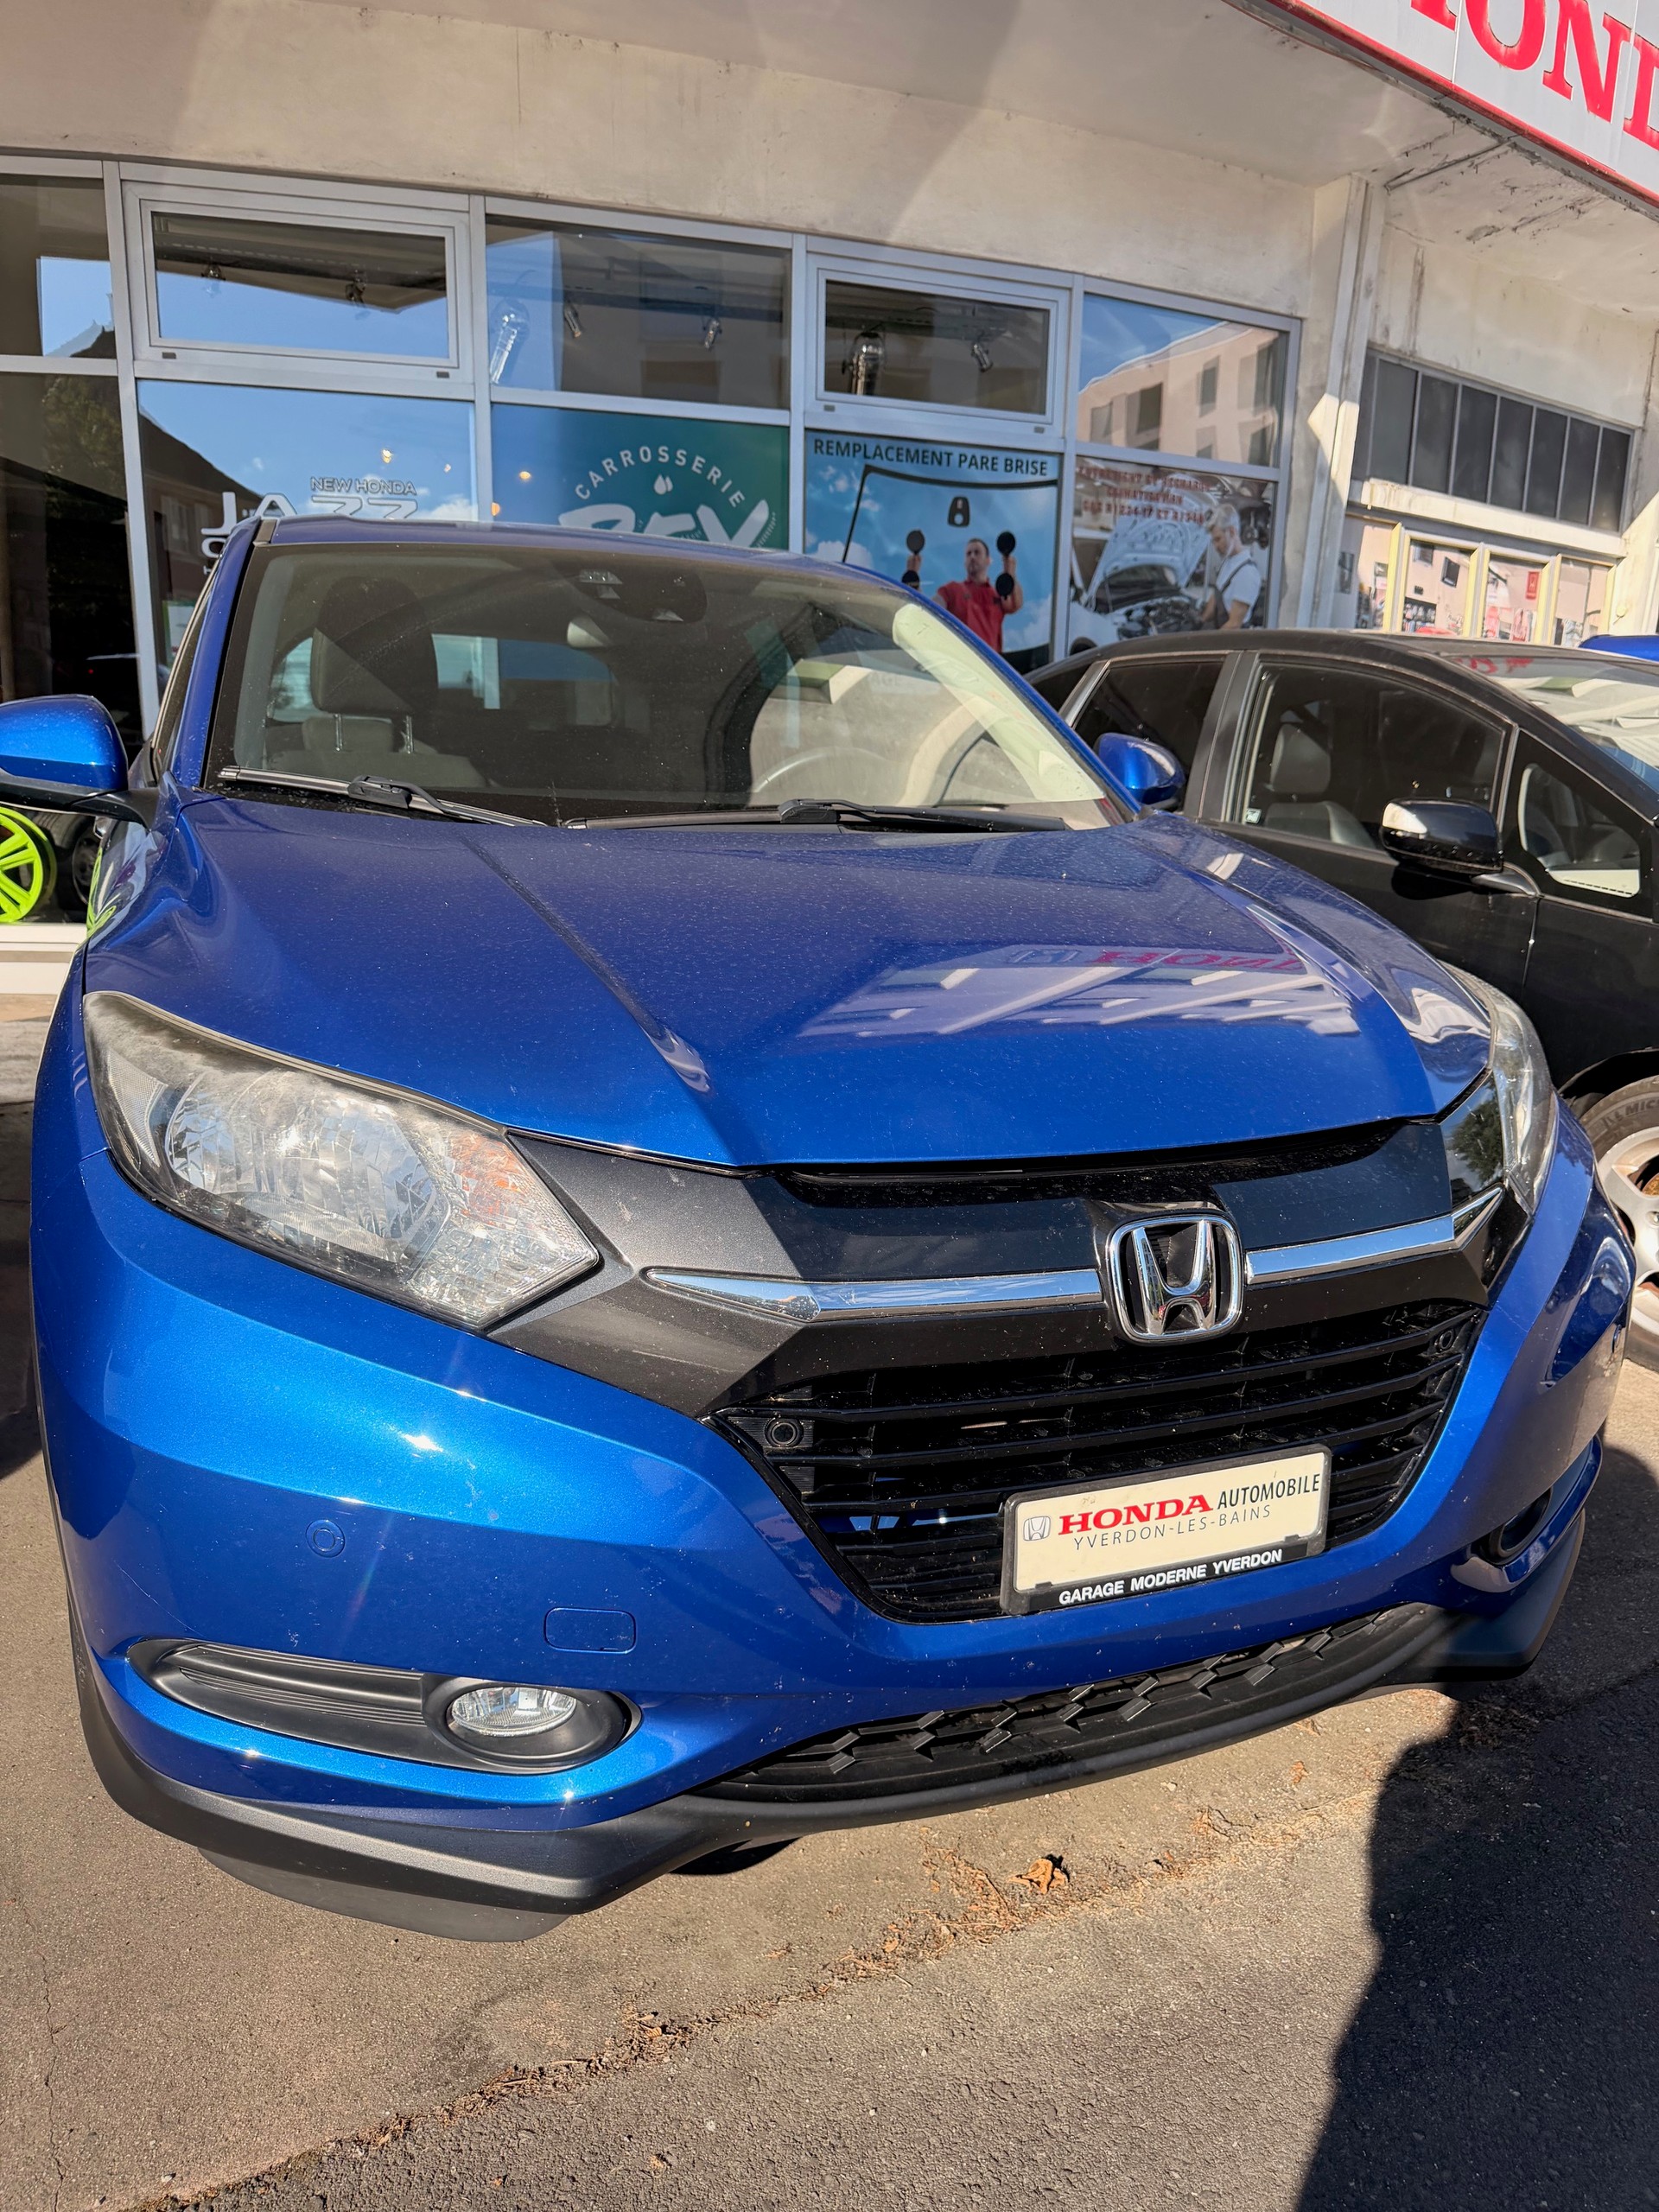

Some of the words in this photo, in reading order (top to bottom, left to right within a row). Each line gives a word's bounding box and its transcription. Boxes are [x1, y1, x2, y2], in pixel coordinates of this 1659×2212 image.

[1411, 0, 1659, 151] ON
[575, 446, 746, 507] CARROSSERIE
[814, 438, 953, 467] REMPLACEMENT
[958, 453, 998, 471] PARE
[1004, 458, 1048, 476] BRISE
[310, 476, 353, 493] NEW
[355, 479, 417, 495] HONDA
[1625, 1099, 1659, 1115] MIC
[1058, 1494, 1214, 1535] HONDA
[1217, 1473, 1321, 1510] AUTOMOBILE
[1073, 1504, 1271, 1550] YVERDON-LES-BAINS
[1058, 1580, 1124, 1605] GARAGE
[1130, 1564, 1207, 1592] MODERNE
[1213, 1548, 1282, 1575] YVERDON
